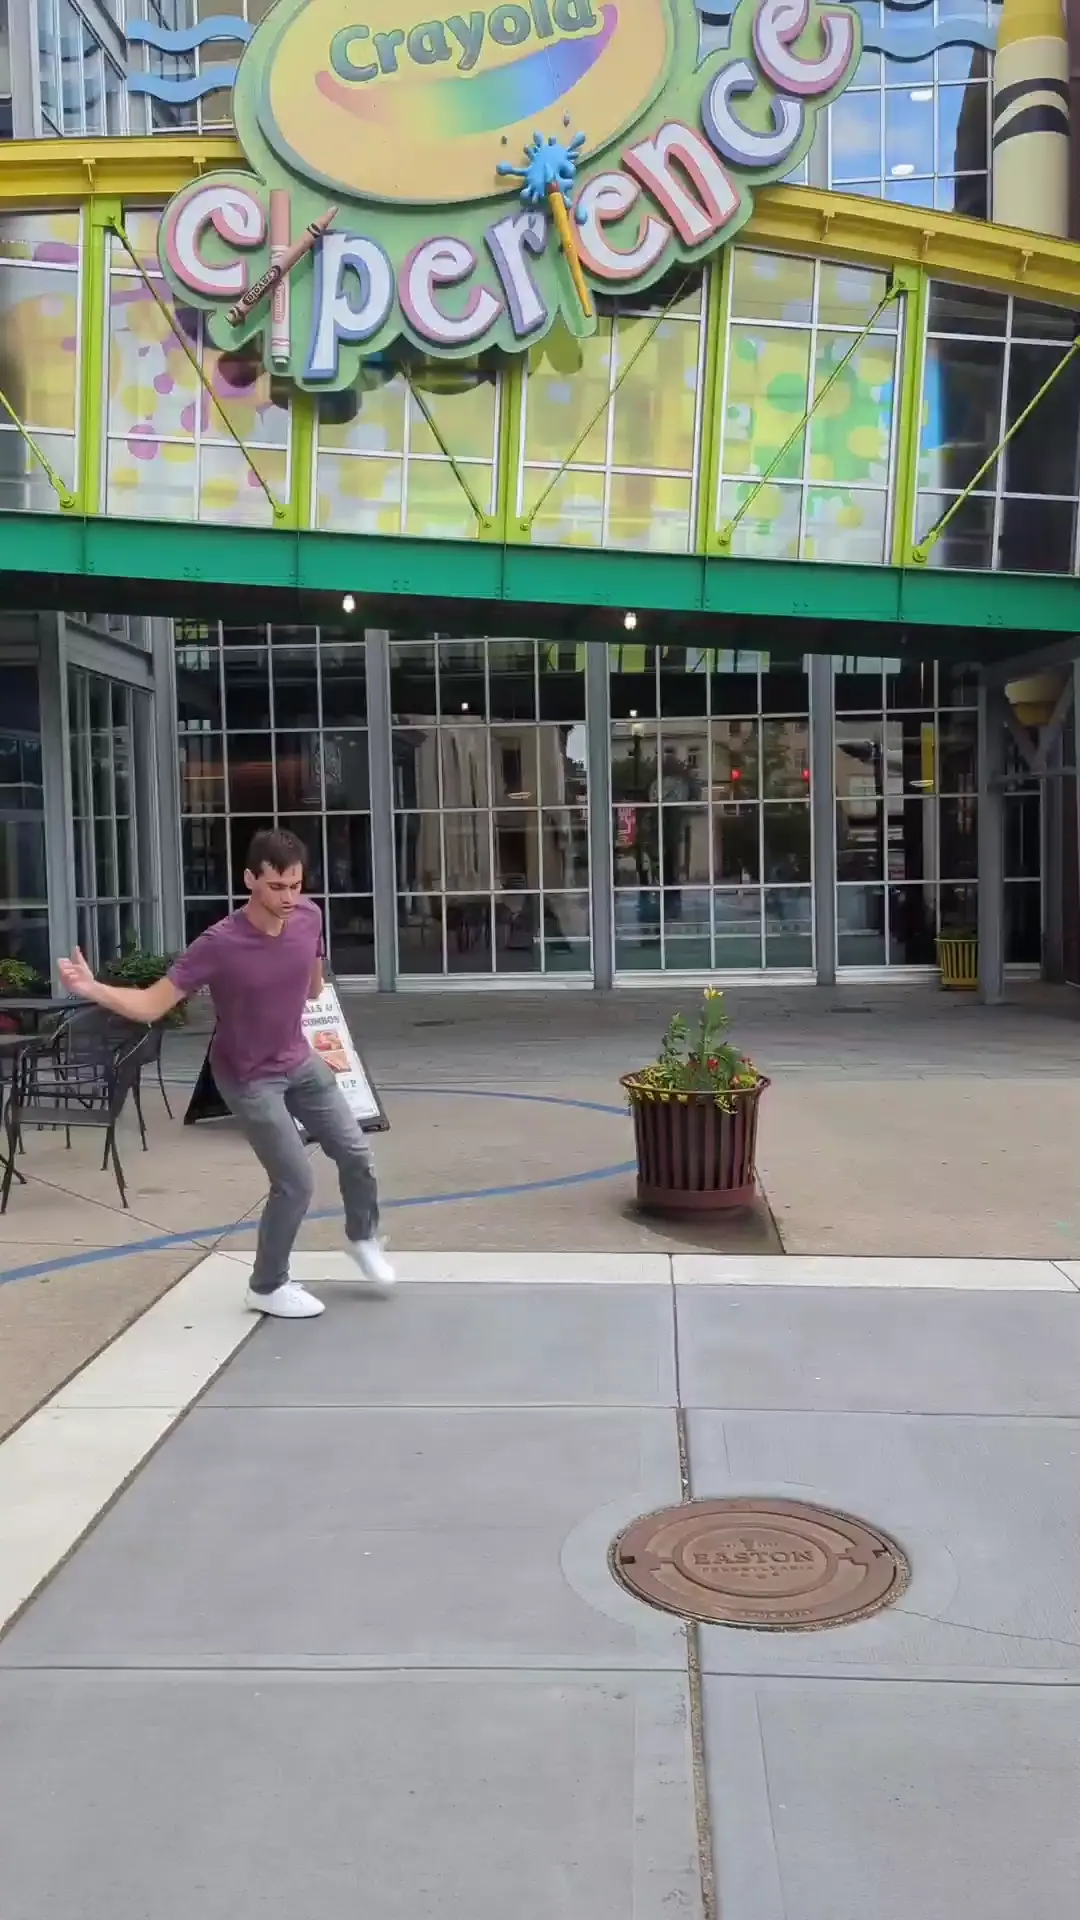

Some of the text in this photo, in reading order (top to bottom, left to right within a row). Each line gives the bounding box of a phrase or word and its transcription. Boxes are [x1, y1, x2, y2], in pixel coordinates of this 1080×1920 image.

[329, 0, 597, 82] Crayola
[245, 267, 280, 303] Crayola
[693, 1550, 815, 1565] EASTON
